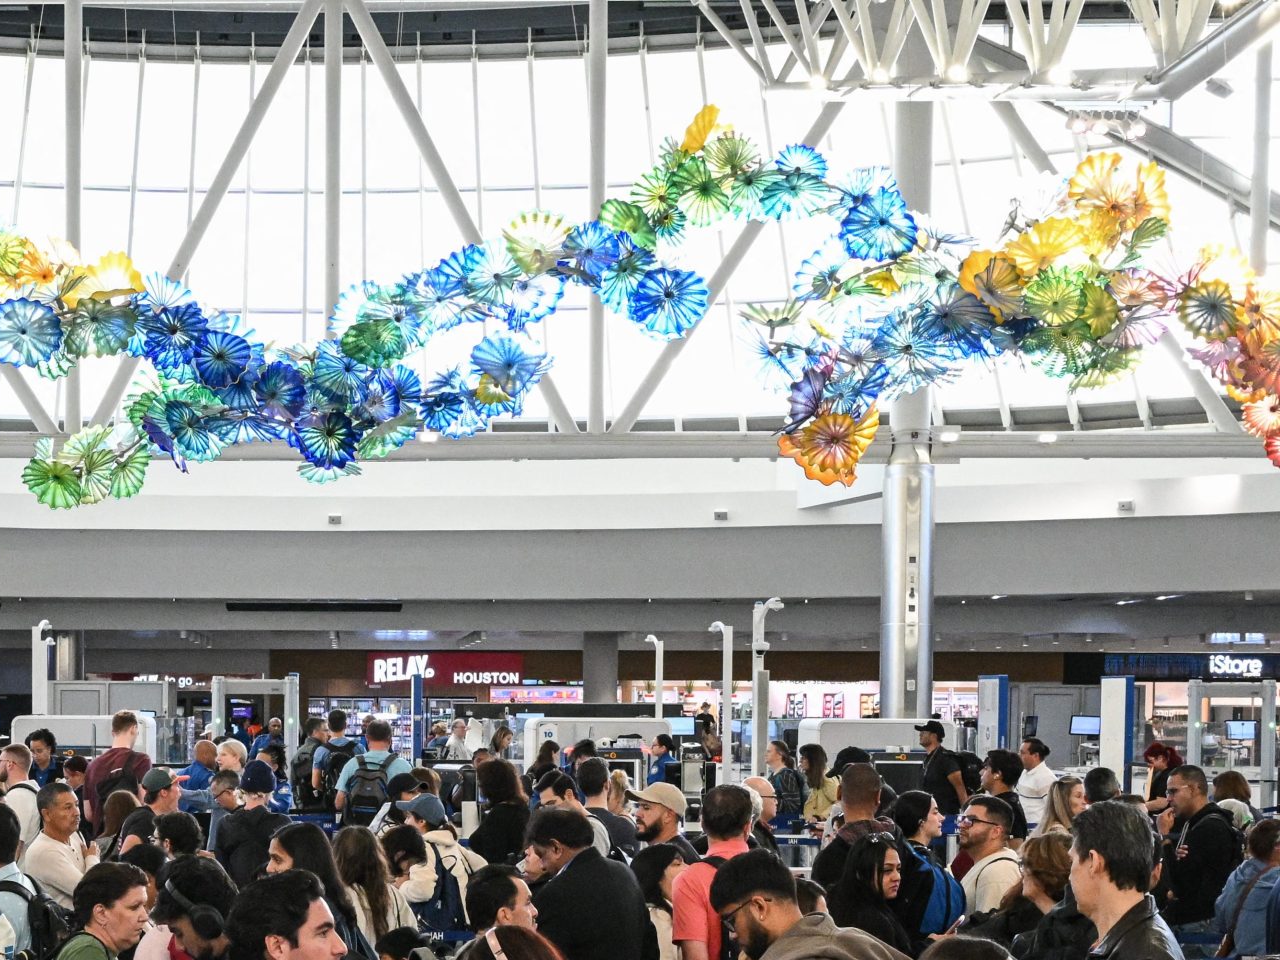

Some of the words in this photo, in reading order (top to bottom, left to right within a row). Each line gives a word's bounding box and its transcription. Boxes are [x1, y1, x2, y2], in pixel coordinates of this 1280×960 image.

[374, 654, 429, 683] RELAY
[1209, 654, 1263, 675] iStore
[178, 676, 193, 688] go
[453, 672, 520, 684] HOUSTON
[430, 932, 444, 940] IAH
